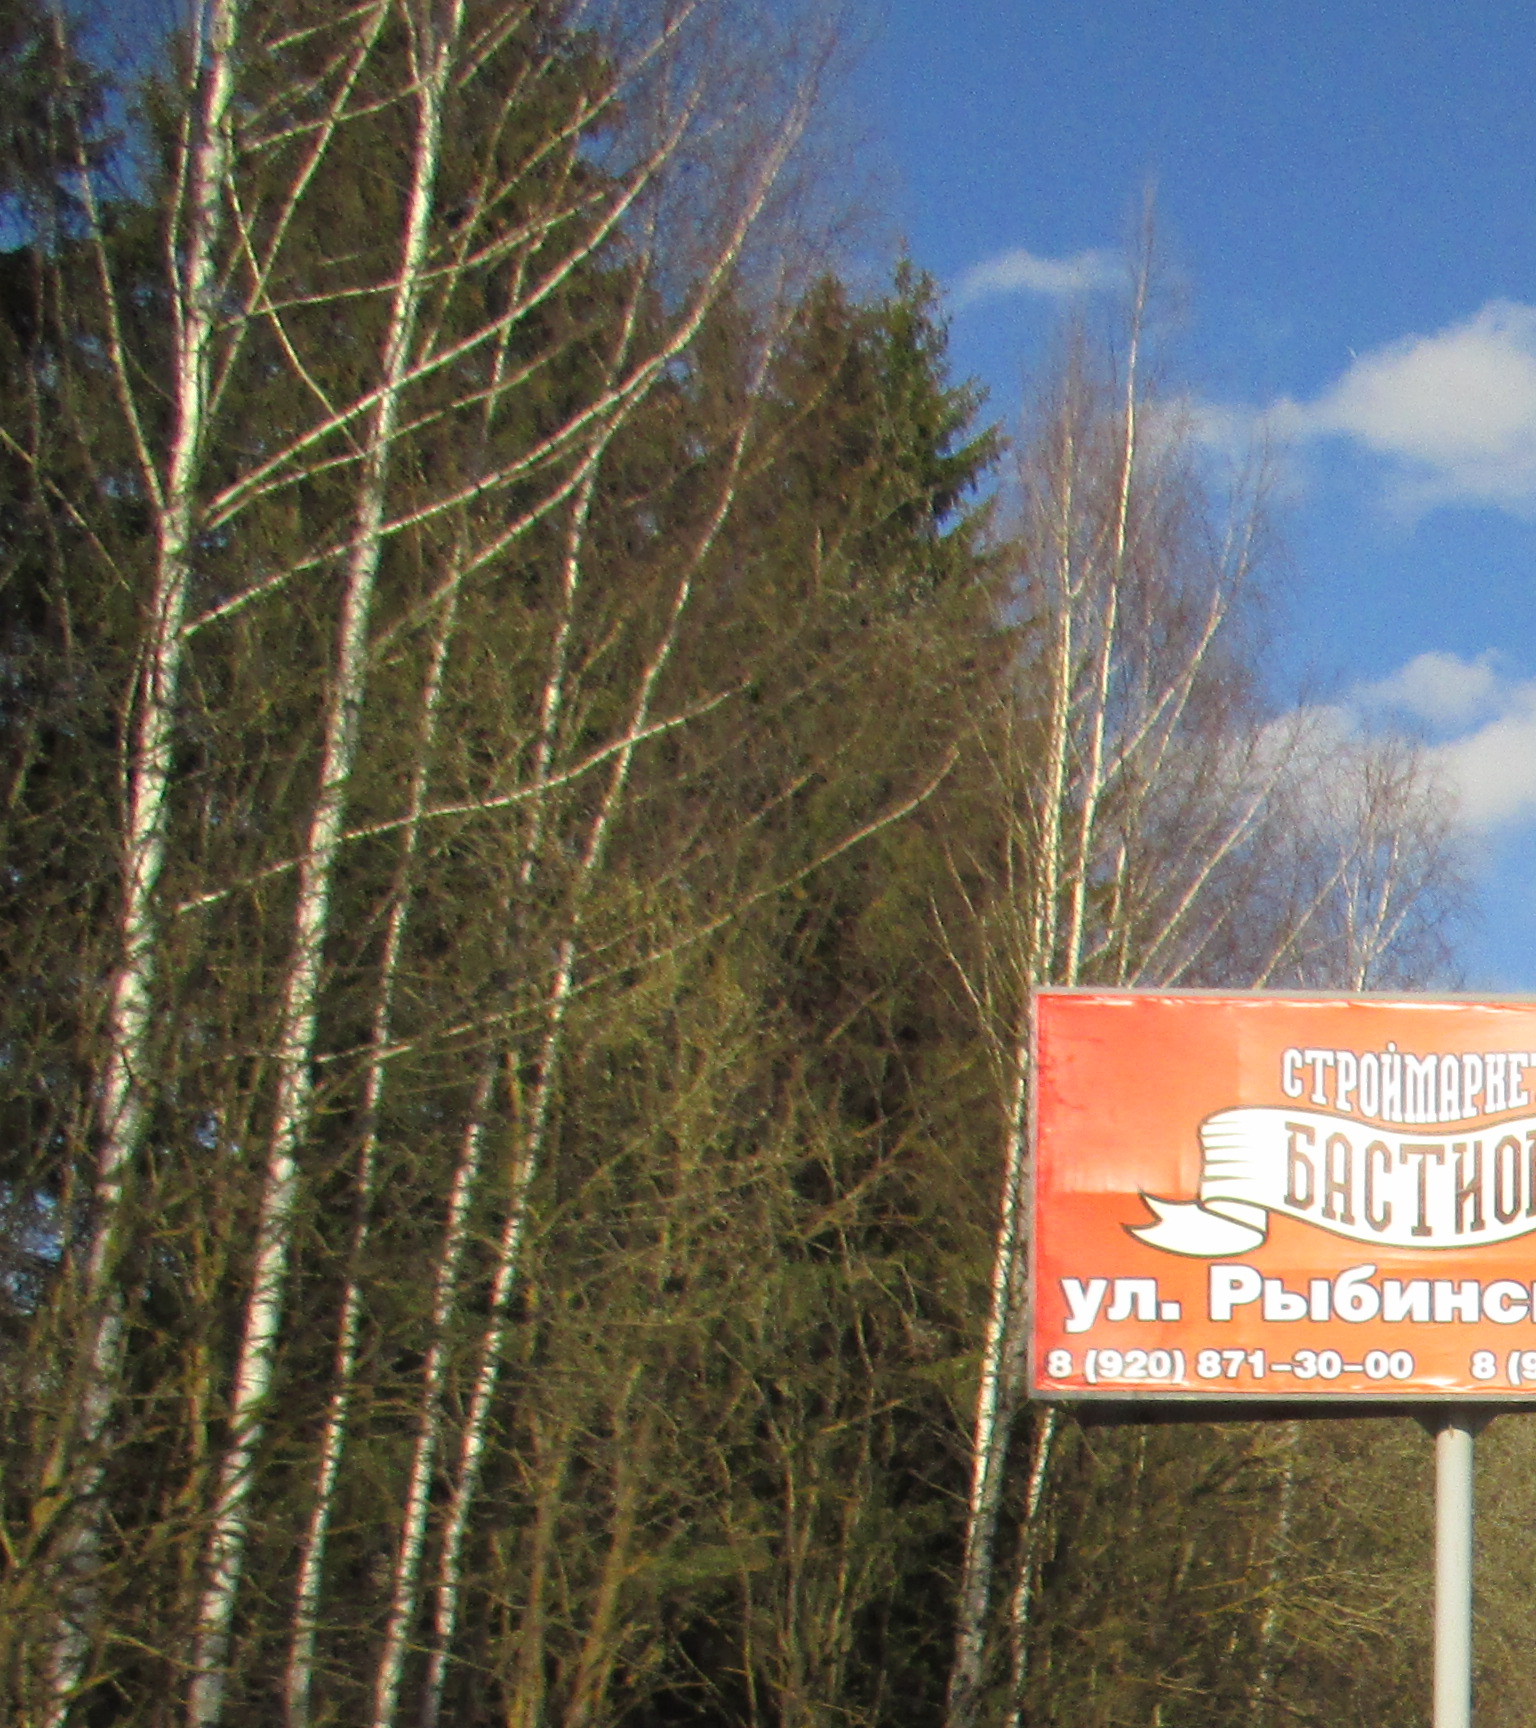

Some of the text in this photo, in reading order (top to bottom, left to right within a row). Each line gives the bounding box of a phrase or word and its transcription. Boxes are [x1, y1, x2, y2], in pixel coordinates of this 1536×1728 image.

[1060, 1277, 1182, 1334] ул.
[1047, 1350, 1073, 1379] 8
[1084, 1349, 1186, 1384] (920)
[1470, 1351, 1497, 1380] 8
